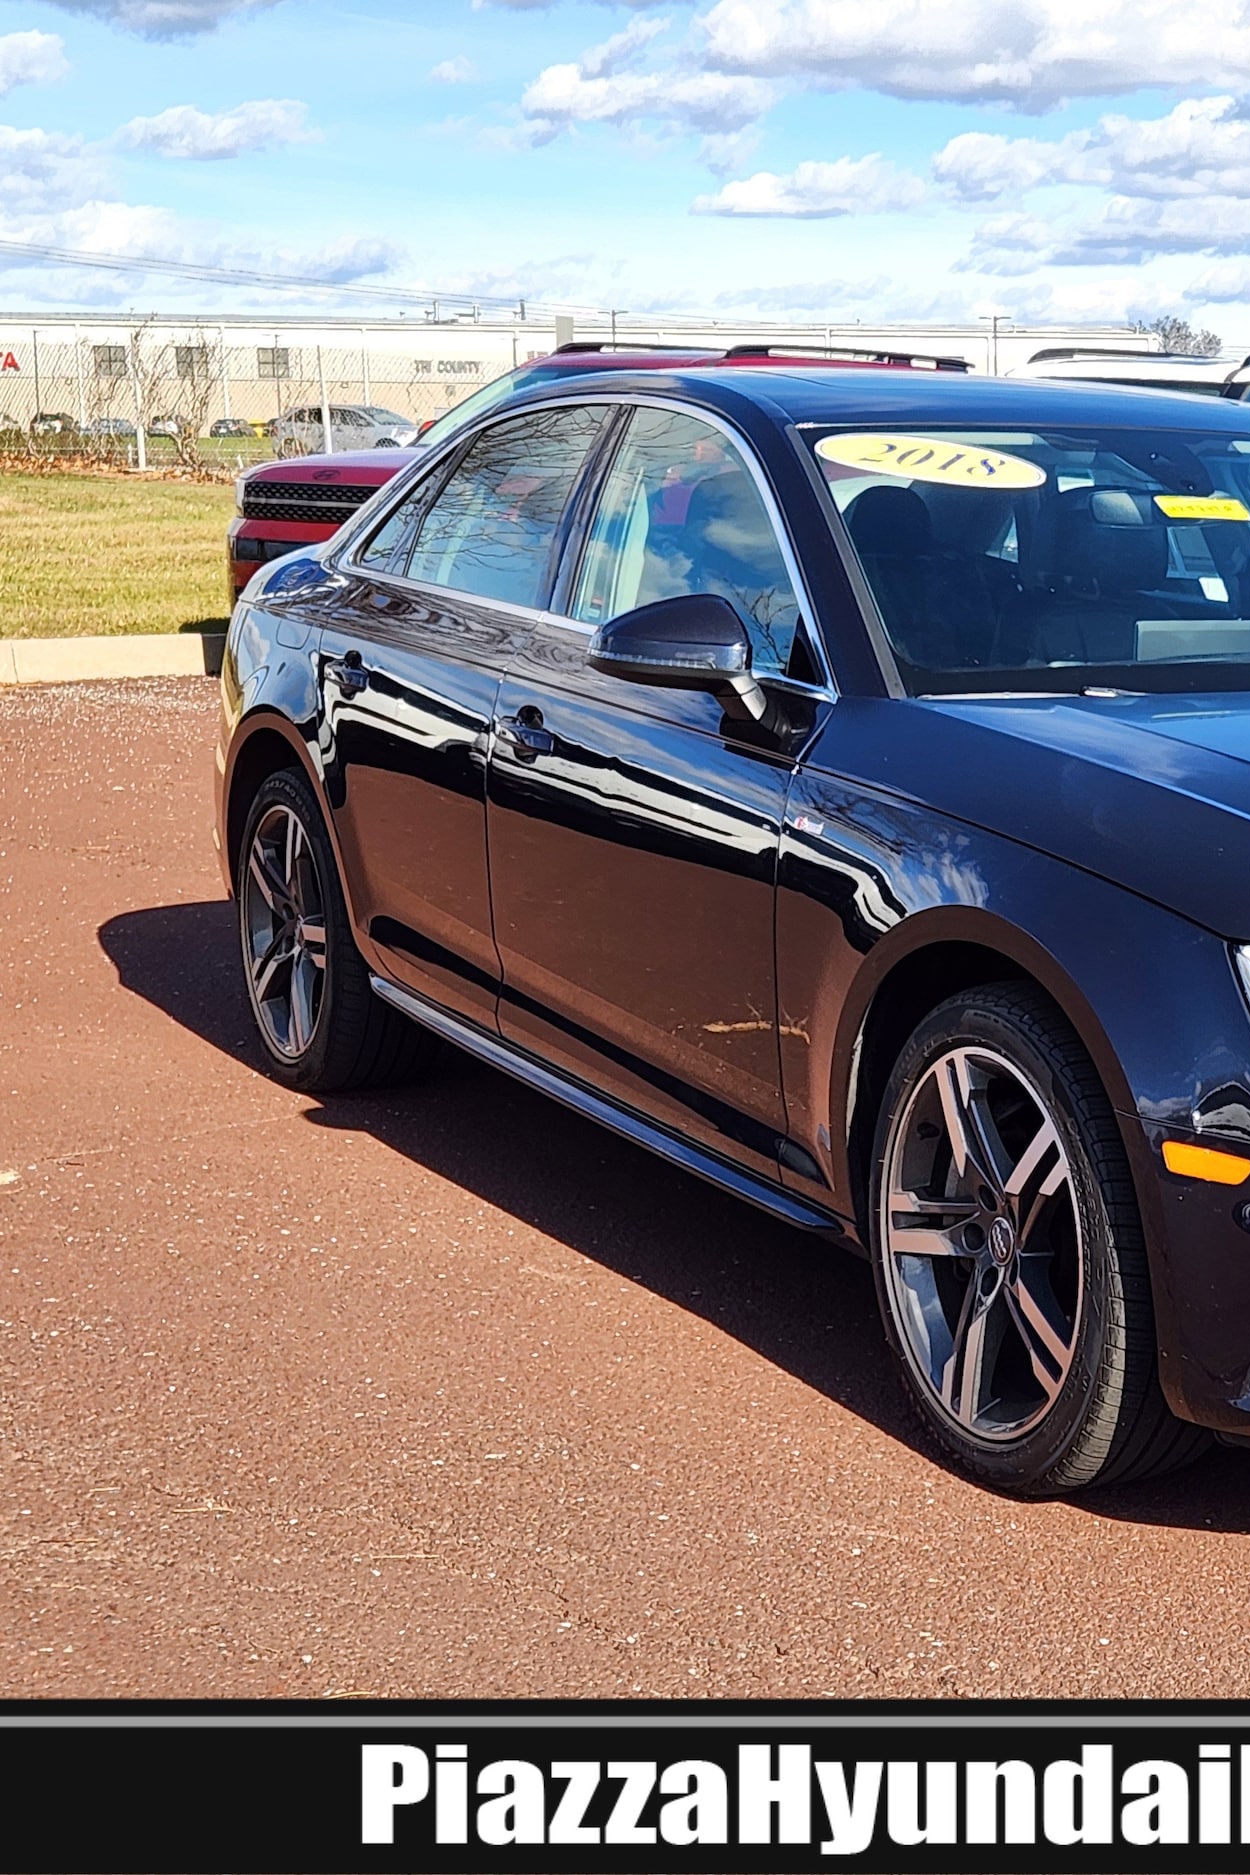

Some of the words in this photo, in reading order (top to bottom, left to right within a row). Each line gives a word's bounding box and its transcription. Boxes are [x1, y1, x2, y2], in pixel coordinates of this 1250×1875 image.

[0, 351, 20, 371] A
[437, 360, 480, 374] COUNTY
[858, 443, 1006, 476] 2018
